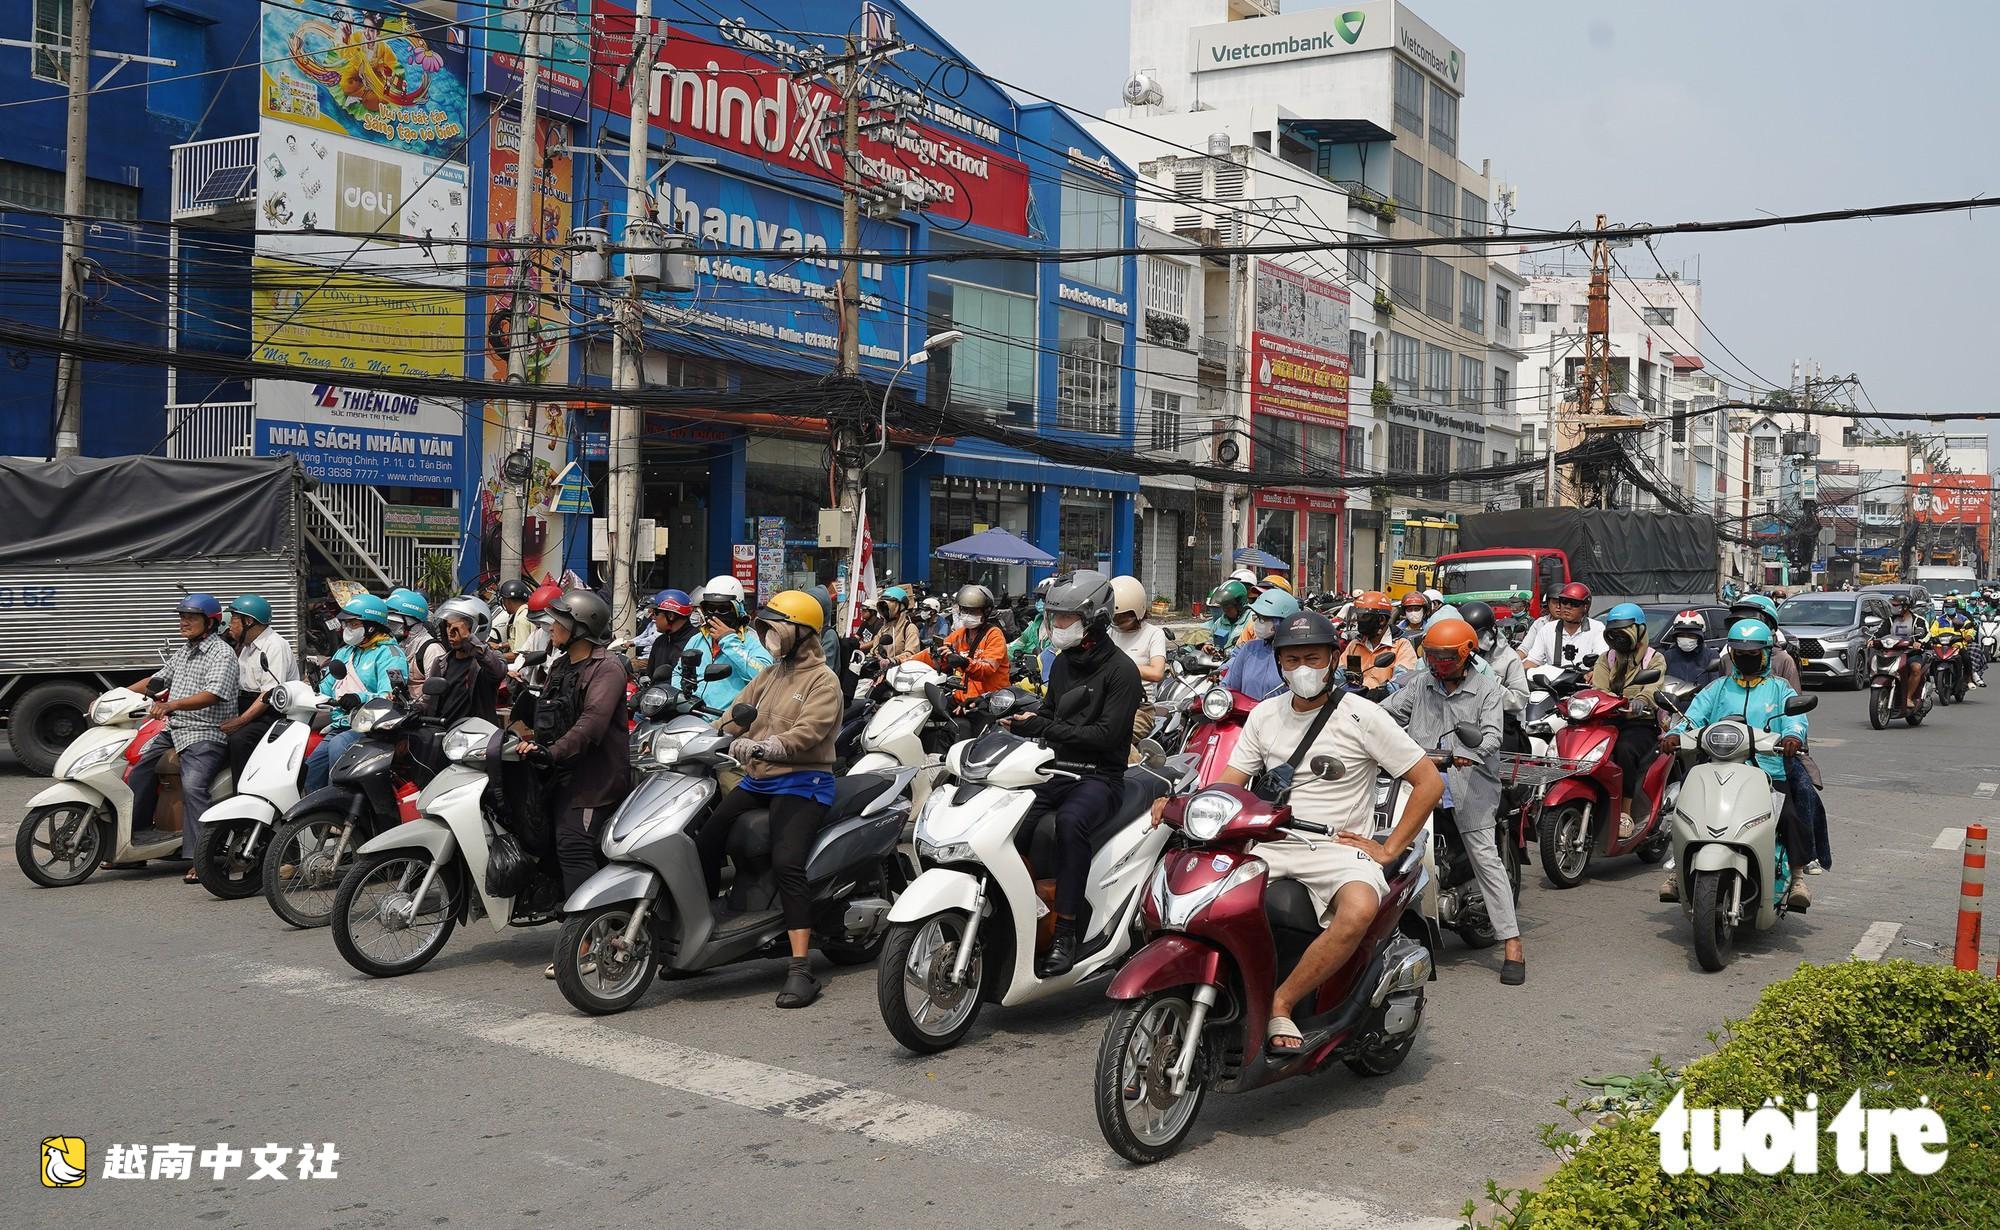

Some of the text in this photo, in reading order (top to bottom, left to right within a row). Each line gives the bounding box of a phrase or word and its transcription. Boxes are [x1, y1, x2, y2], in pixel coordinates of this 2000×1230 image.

[1212, 31, 1335, 63] Vietcombank
[1401, 27, 1449, 78] Vietcombank
[939, 140, 989, 180] School
[344, 186, 393, 216] deli
[712, 259, 752, 284] SÁCH
[754, 270, 767, 288] &
[323, 288, 355, 304] CÔNG
[298, 352, 331, 368] Trang
[269, 424, 453, 457] NHÀ SÁCH NHÂN VĂN
[307, 467, 325, 477] 028
[327, 468, 352, 478] 3636
[355, 470, 379, 480] 7777
[324, 453, 352, 467] Trường
